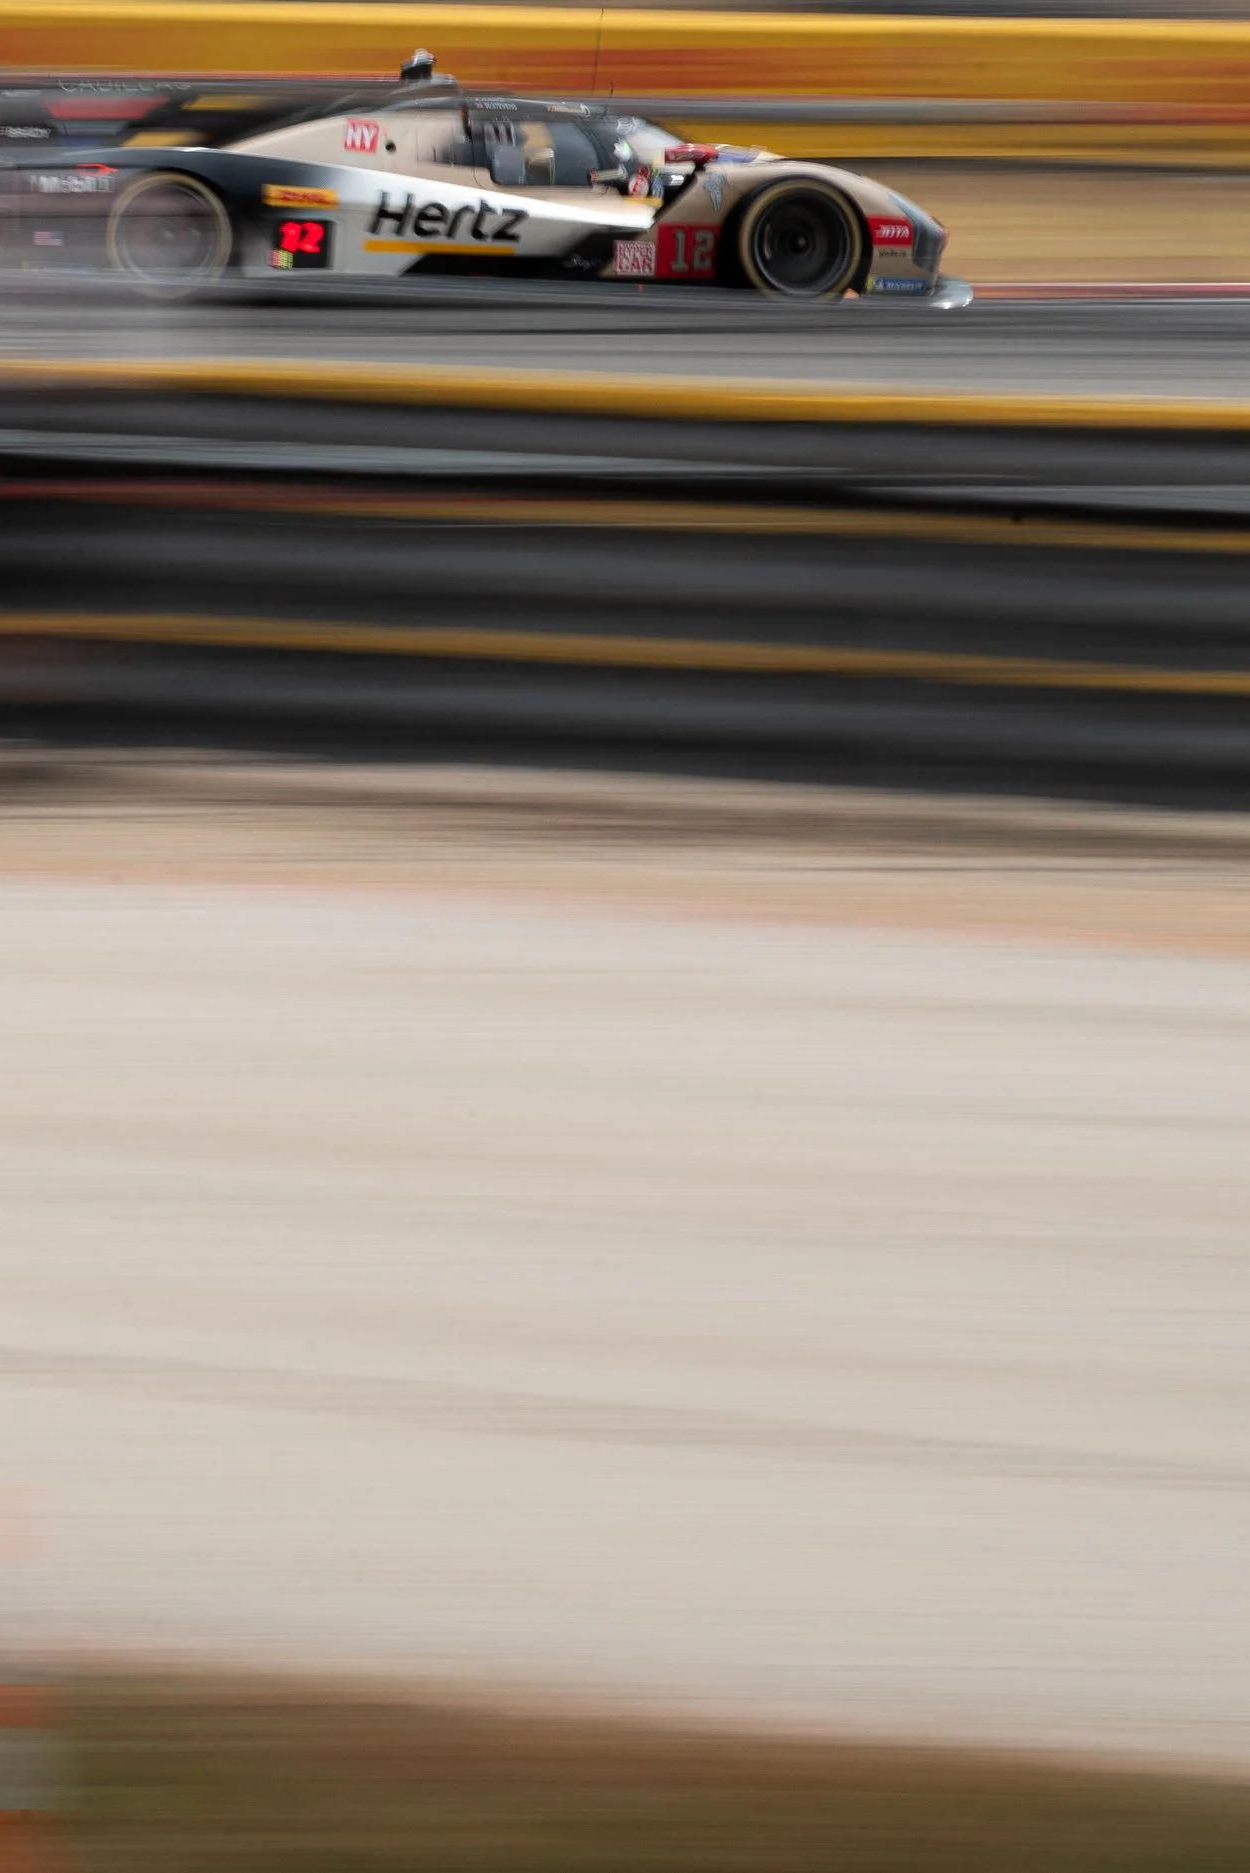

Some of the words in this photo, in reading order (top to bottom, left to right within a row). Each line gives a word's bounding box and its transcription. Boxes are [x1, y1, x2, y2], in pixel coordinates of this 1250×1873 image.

[279, 221, 325, 254] 12
[366, 190, 529, 243] Hertz
[671, 229, 714, 272] 12
